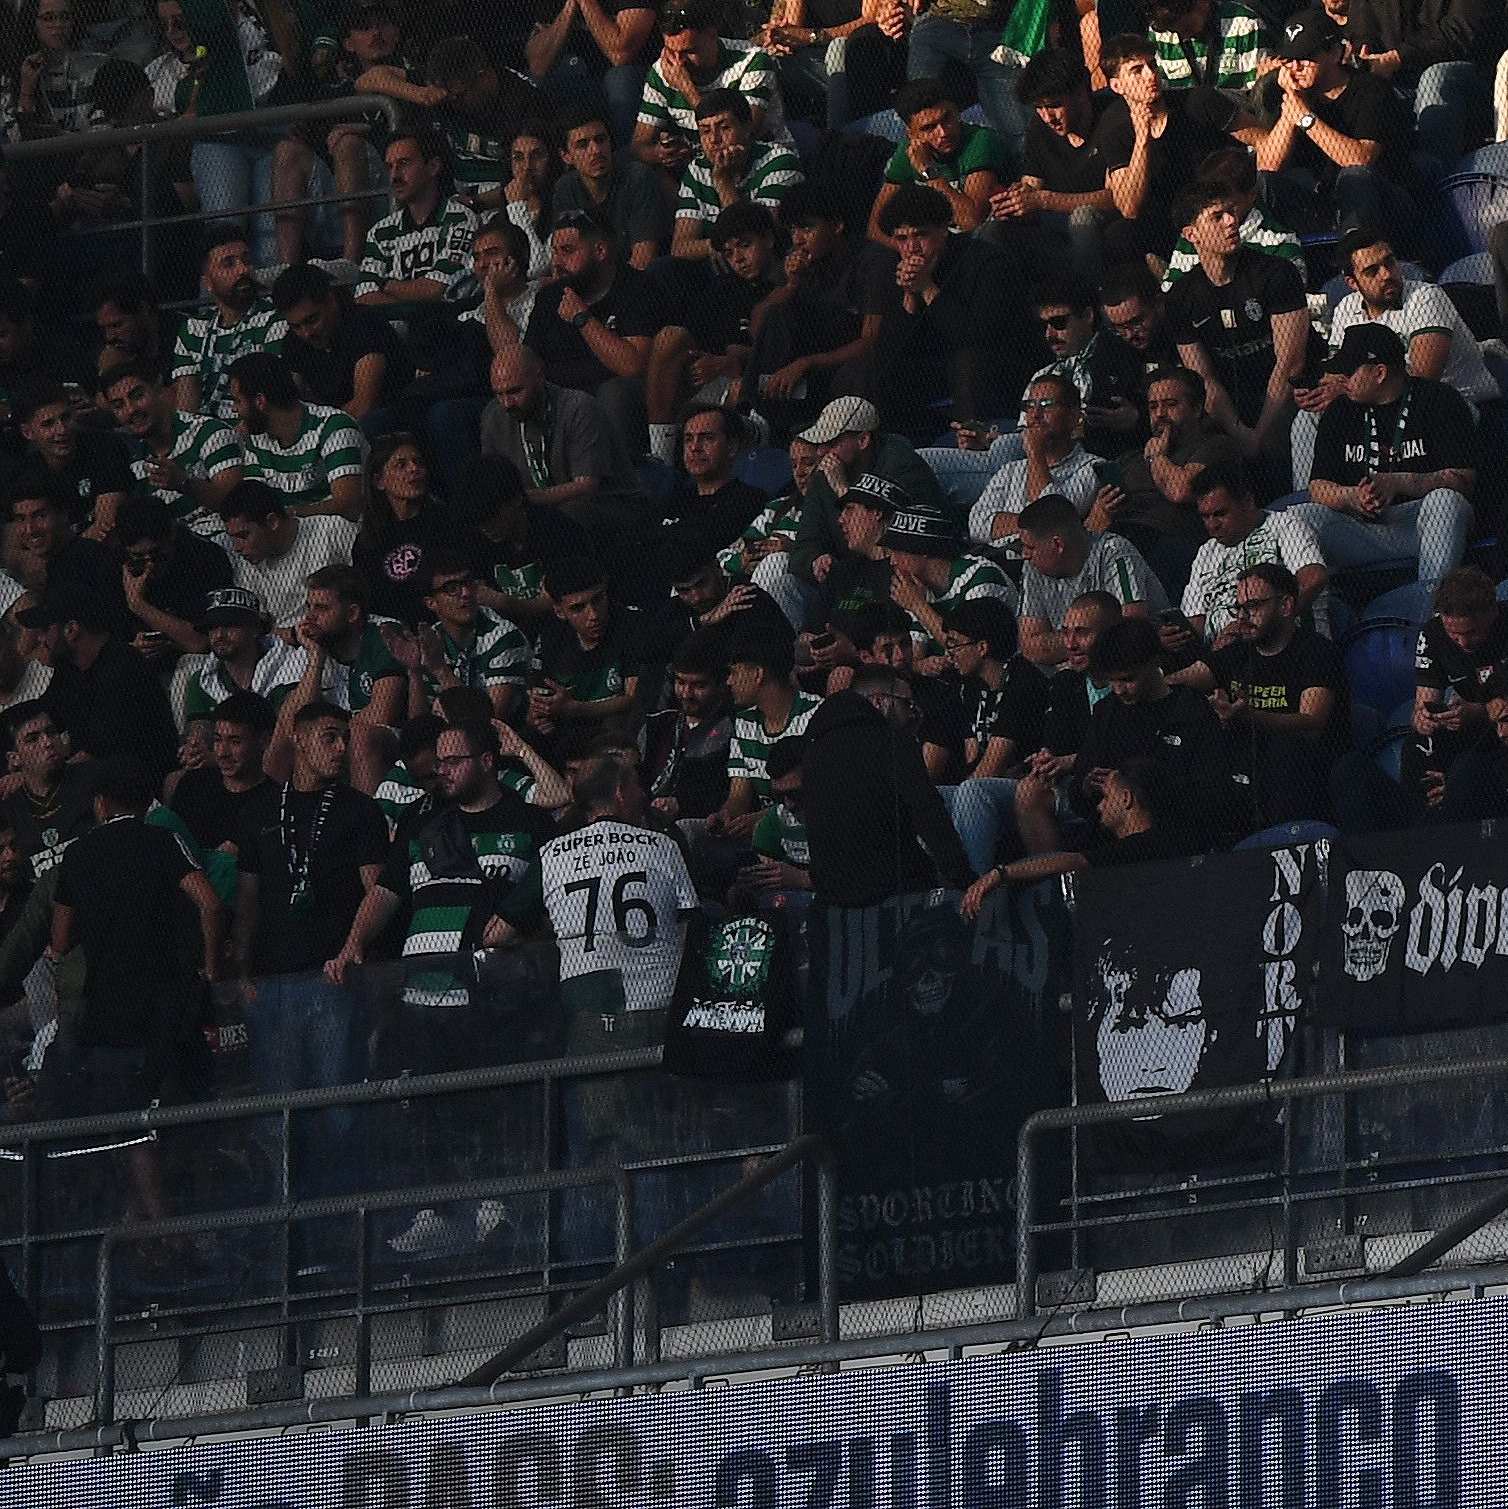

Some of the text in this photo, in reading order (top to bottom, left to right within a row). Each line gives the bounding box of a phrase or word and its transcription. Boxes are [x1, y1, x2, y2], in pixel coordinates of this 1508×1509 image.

[553, 832, 661, 858] SUPER BOCK
[600, 846, 637, 868] JOÃO
[563, 872, 659, 952] 76
[1256, 845, 1313, 1124] NORT
